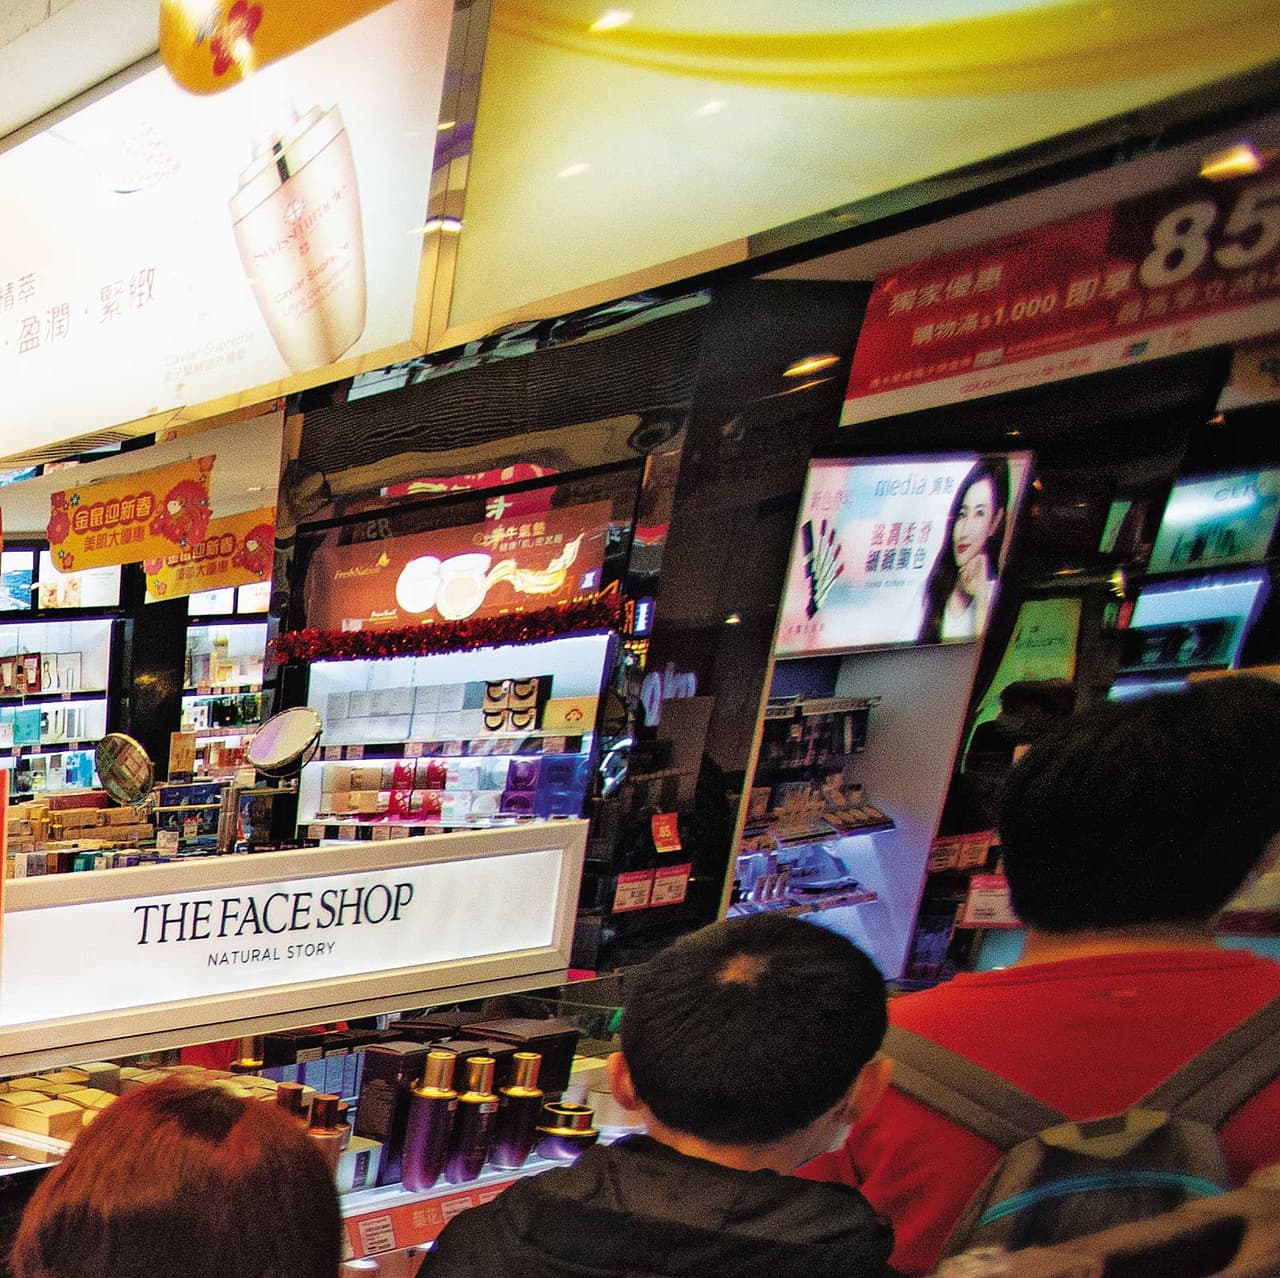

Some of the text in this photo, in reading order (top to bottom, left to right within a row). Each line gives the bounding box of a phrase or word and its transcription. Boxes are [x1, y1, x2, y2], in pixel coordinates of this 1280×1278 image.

[1140, 188, 1280, 290] 85
[74, 495, 152, 531] 金鼠迎新春
[133, 881, 415, 946] THE FACE SHOP
[207, 940, 337, 967] NATURAL STORY
